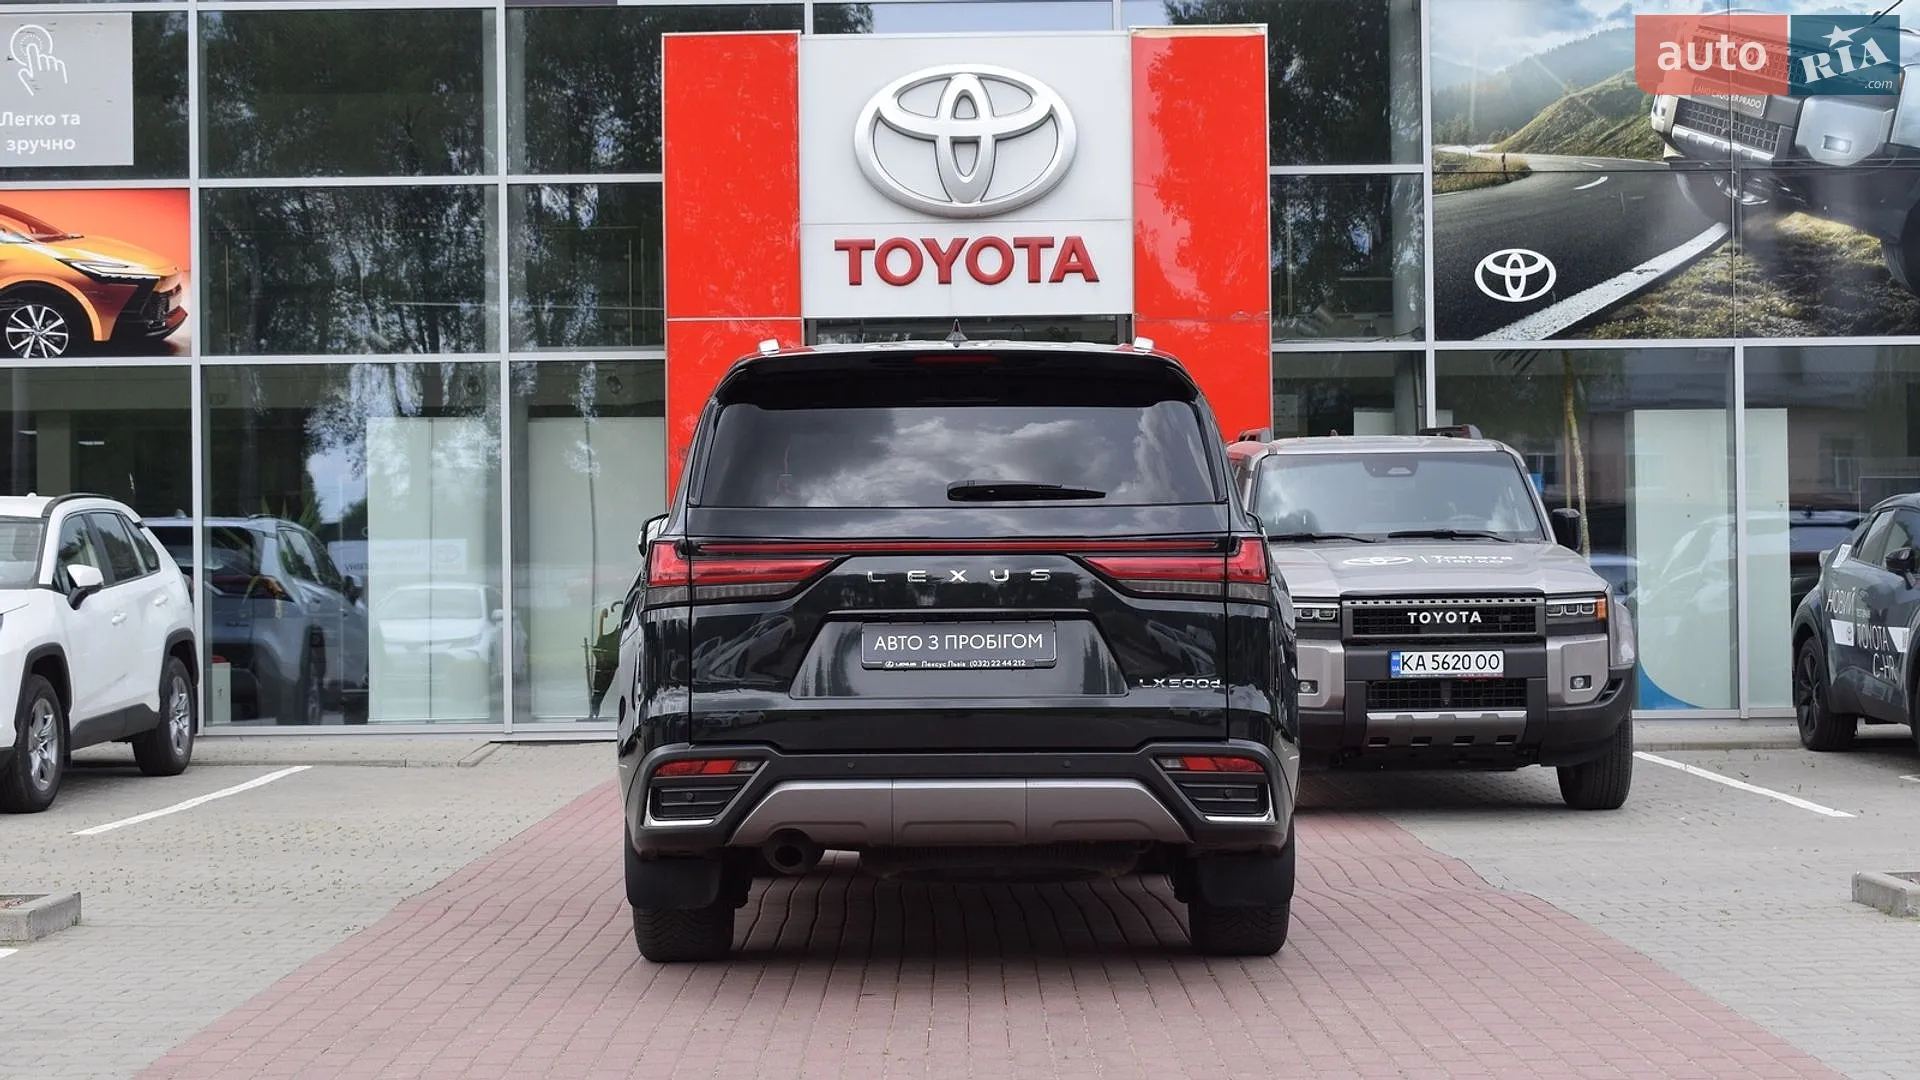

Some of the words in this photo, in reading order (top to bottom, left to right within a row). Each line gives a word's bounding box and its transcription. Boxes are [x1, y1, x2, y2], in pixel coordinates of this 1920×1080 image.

[0, 111, 56, 127] Легко
[60, 113, 81, 126] та
[6, 138, 76, 155] зручно
[834, 236, 1100, 287] TOYOTA
[867, 569, 1051, 583] LEXUS
[1407, 611, 1482, 624] TOYOTA
[874, 635, 923, 651] АВТО
[945, 633, 1043, 650] ПРОБІГОМ
[1856, 623, 1890, 651] TOYOTA
[1401, 654, 1427, 671] KA
[1431, 654, 1472, 671] 5620
